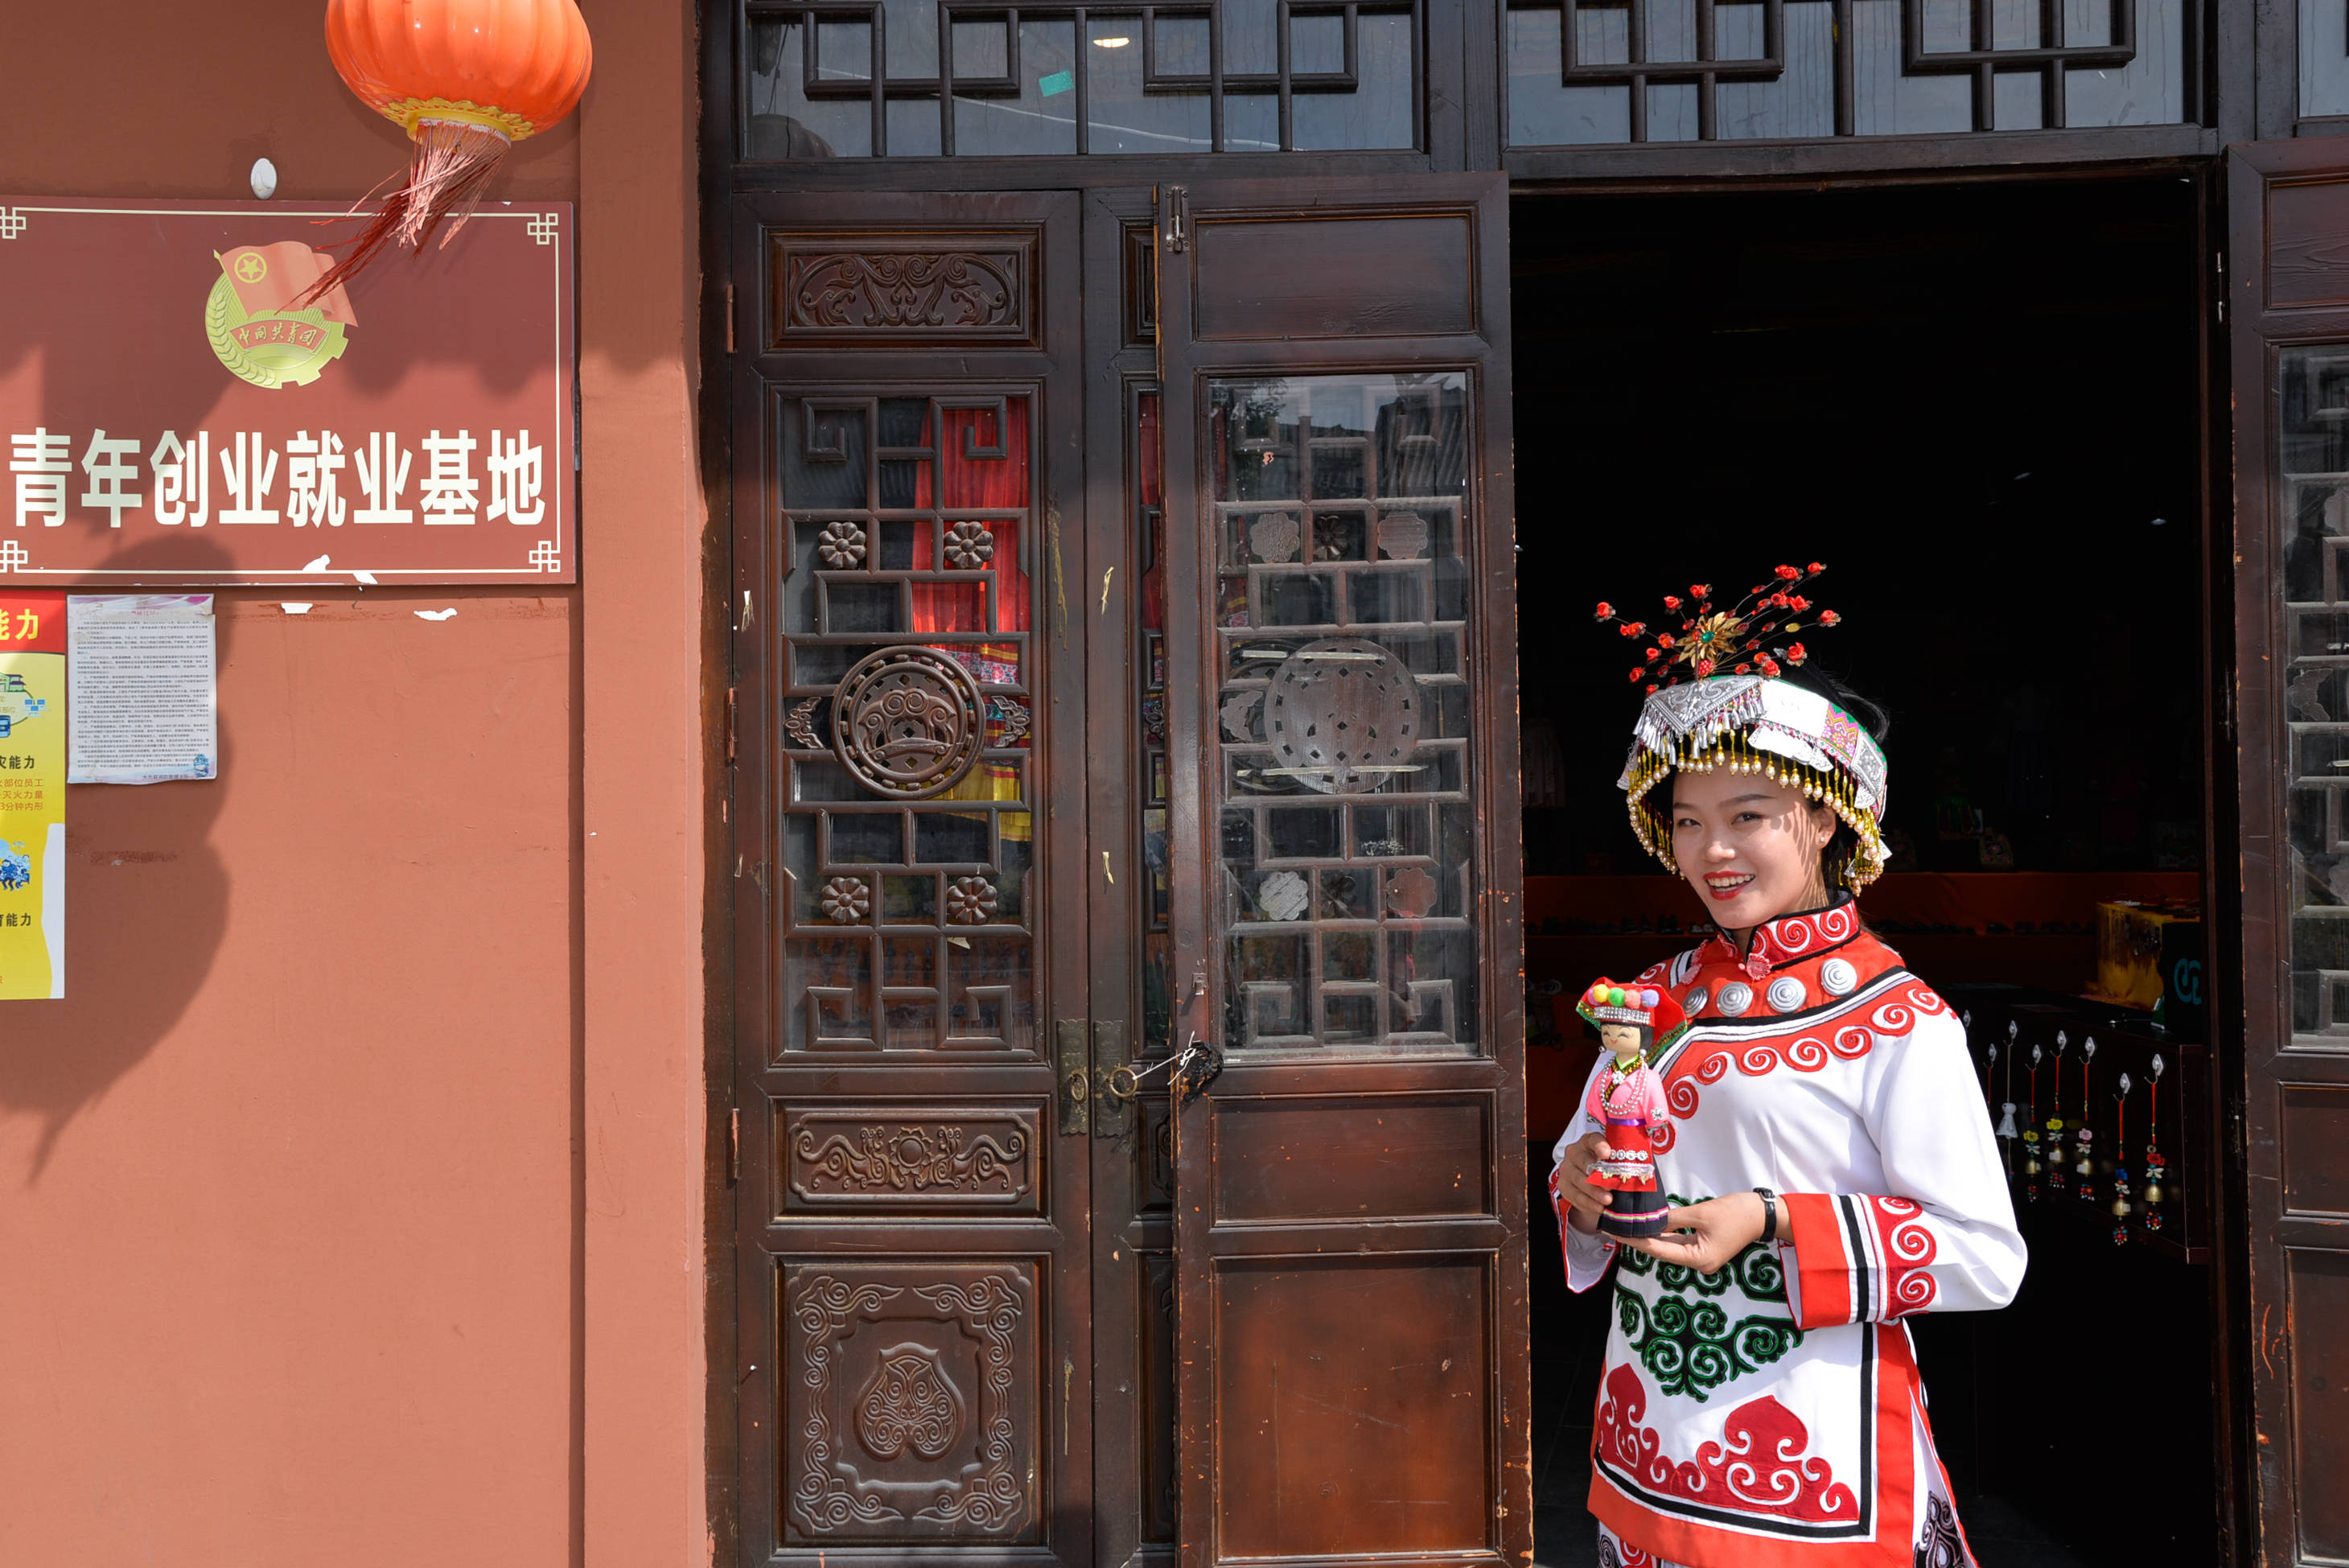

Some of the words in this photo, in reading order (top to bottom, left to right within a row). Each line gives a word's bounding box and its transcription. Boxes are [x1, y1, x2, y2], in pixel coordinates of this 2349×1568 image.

[239, 322, 318, 346] 中国共青团
[9, 427, 546, 528] 青年创业就业基地
[0, 779, 43, 788] 部位员工
